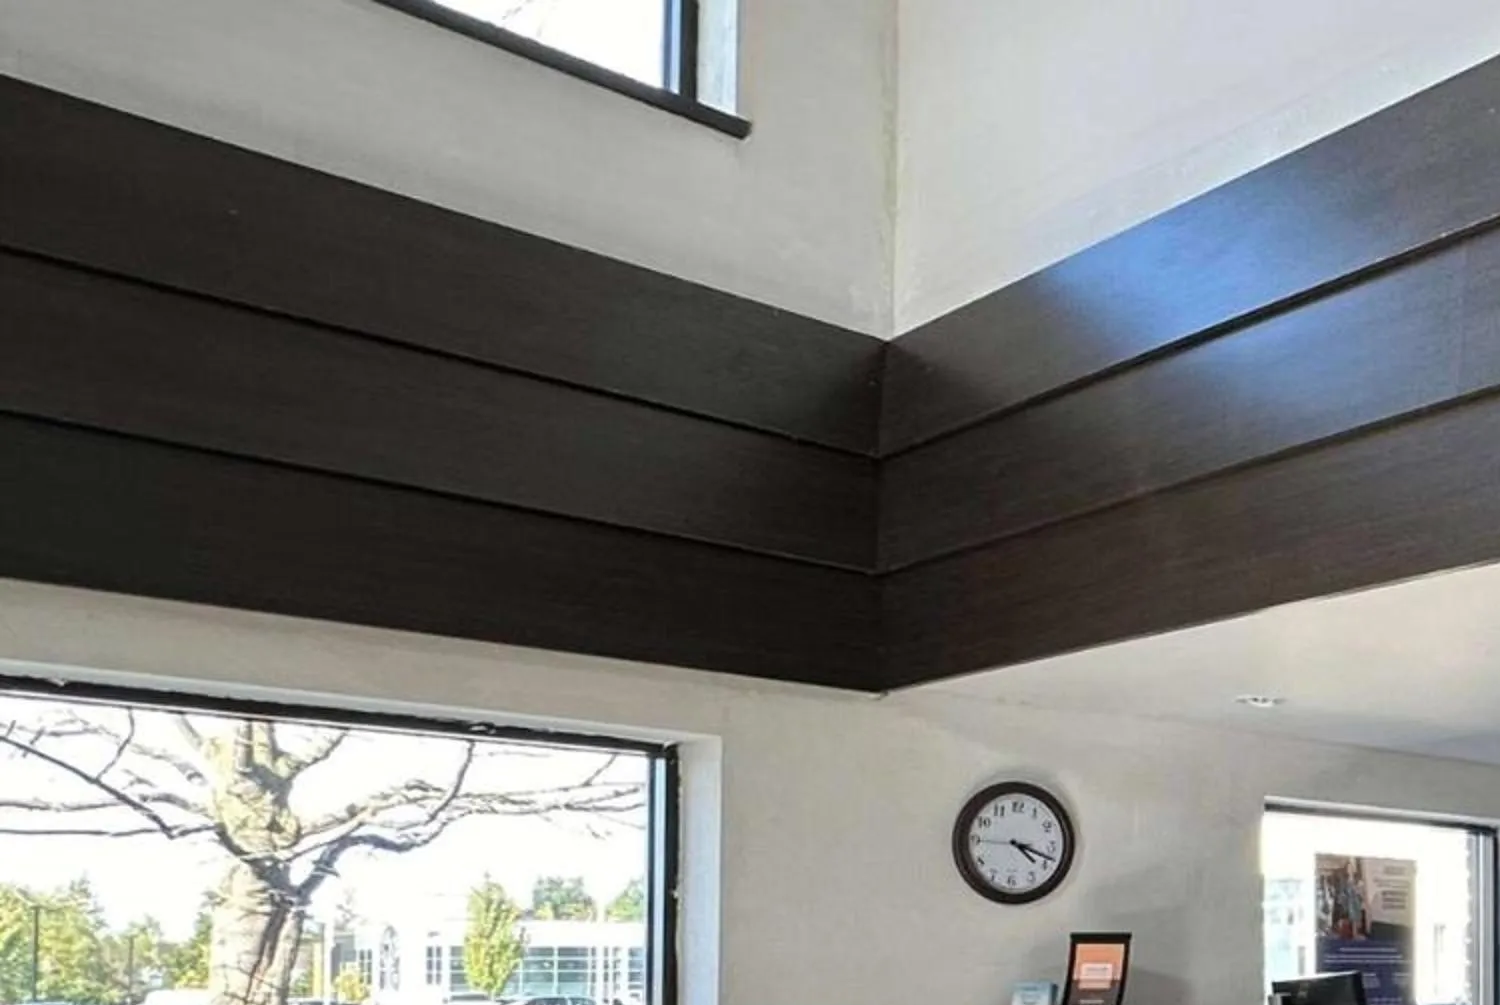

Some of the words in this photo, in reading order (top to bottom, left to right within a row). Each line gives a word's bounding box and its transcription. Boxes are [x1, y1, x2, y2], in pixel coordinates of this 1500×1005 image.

[993, 803, 1006, 817] 11
[1011, 801, 1025, 814] 12
[979, 815, 992, 829] 10
